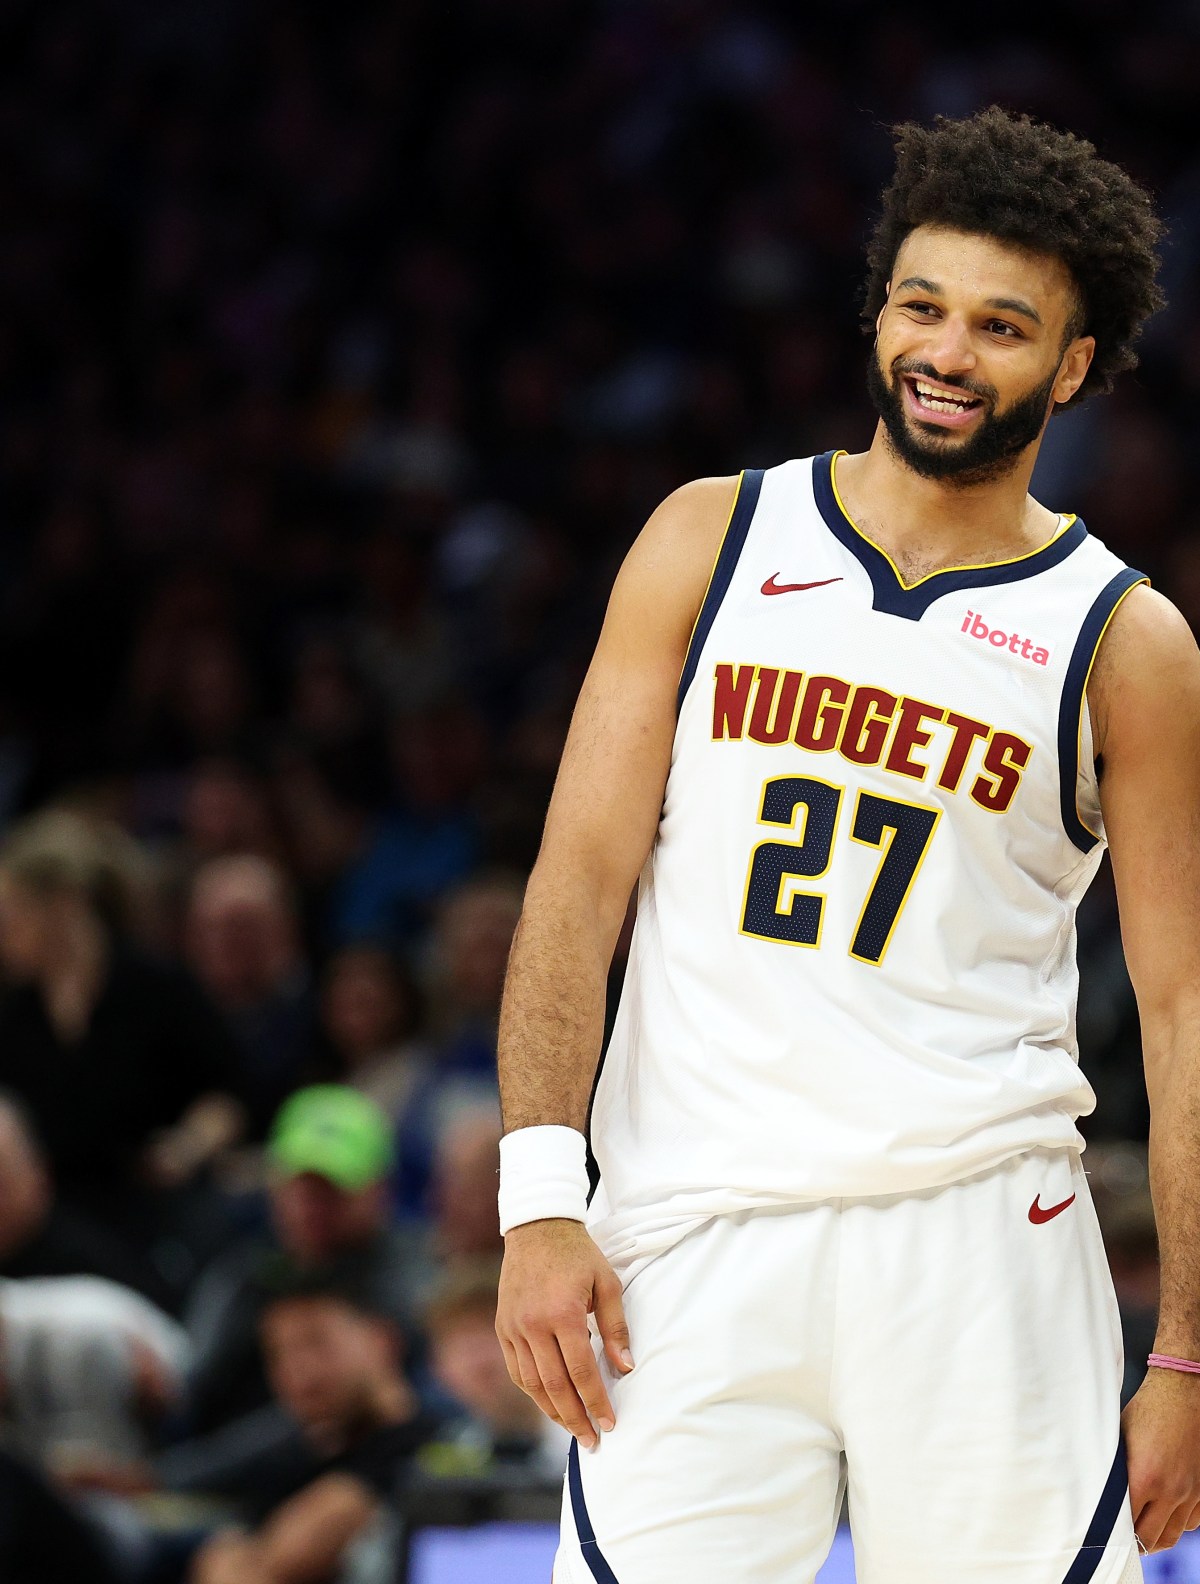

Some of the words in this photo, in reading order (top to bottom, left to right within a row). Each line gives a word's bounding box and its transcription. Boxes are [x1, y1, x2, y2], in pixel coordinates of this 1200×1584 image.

[960, 610, 1050, 666] ibotta
[711, 662, 1035, 814] NUGGETS
[738, 773, 944, 967] 27
